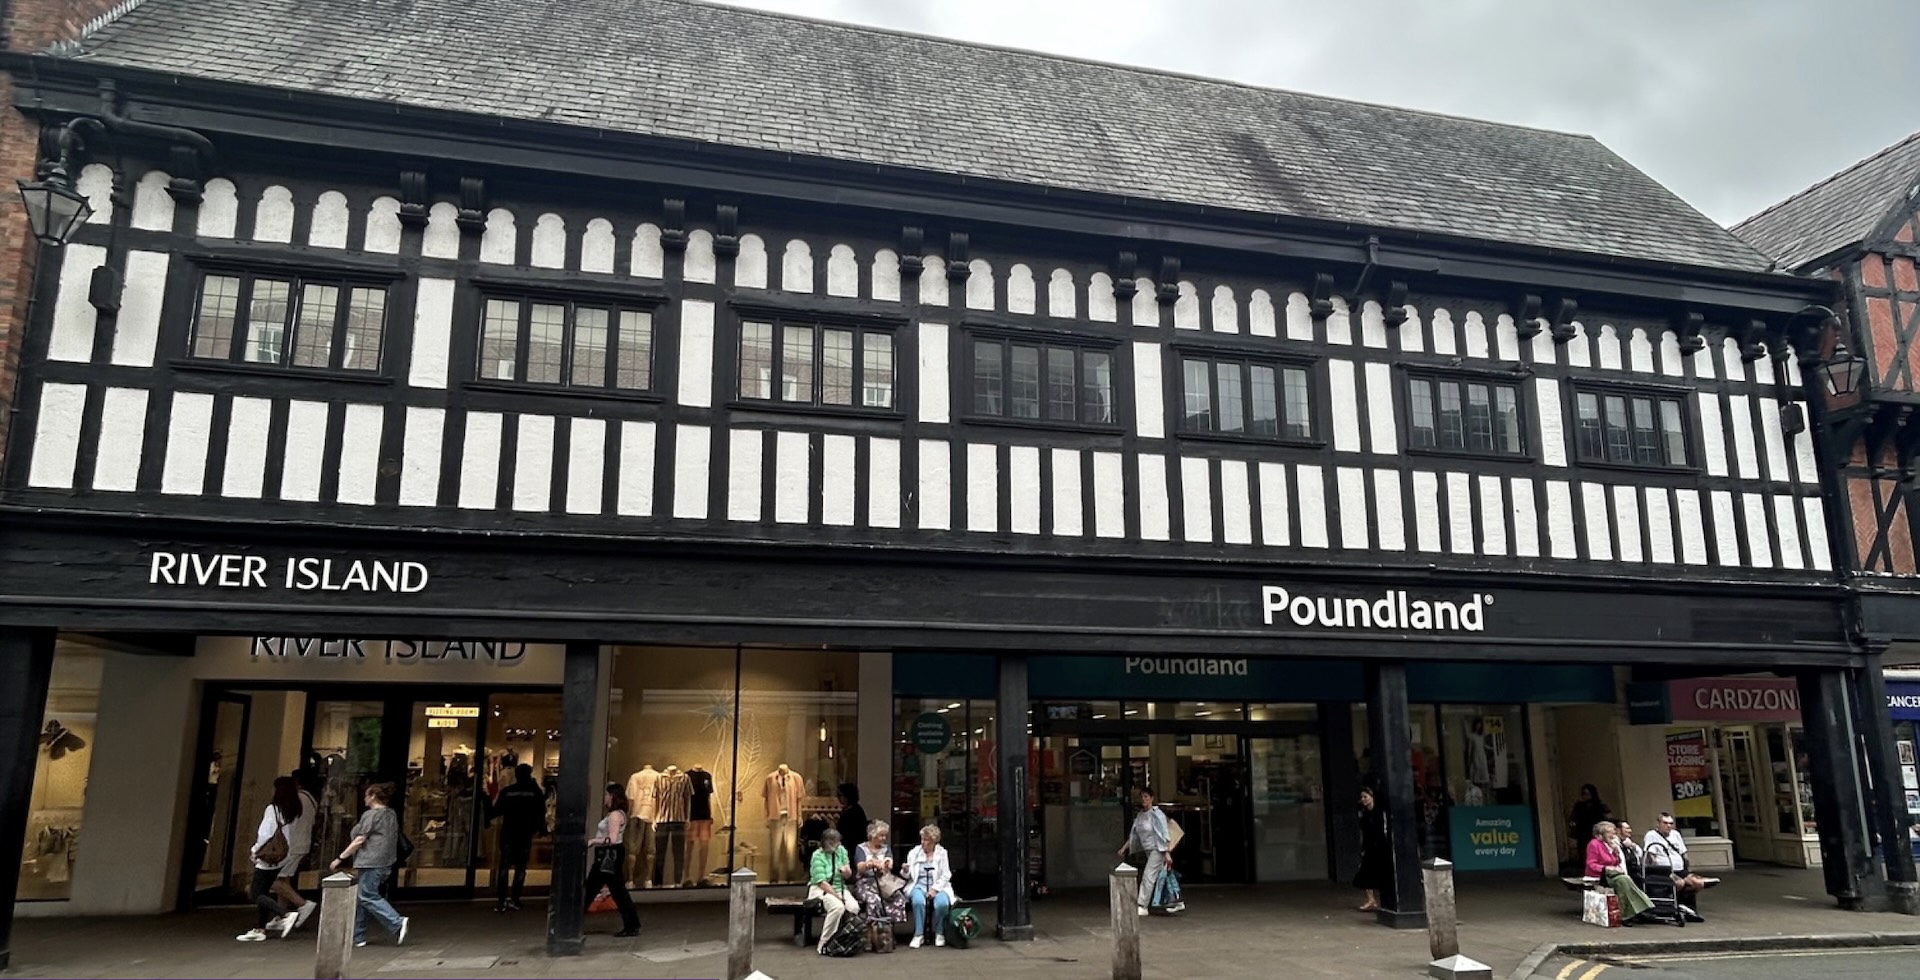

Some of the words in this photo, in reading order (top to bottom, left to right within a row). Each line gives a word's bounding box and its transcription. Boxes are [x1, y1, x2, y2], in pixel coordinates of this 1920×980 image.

[149, 551, 267, 588] RIVER
[285, 557, 428, 593] ISLAND
[250, 635, 365, 659] RIVER
[384, 637, 526, 662] ISLAND
[1125, 656, 1248, 676] Poundland
[1695, 687, 1801, 711] CARDZON
[1669, 744, 1700, 755] STORE
[1667, 755, 1705, 766] CLOSING
[1675, 779, 1704, 799] 30%
[1475, 818, 1511, 828] Amazing
[1469, 827, 1520, 845] value
[1474, 847, 1498, 857] every
[1499, 845, 1517, 857] day
